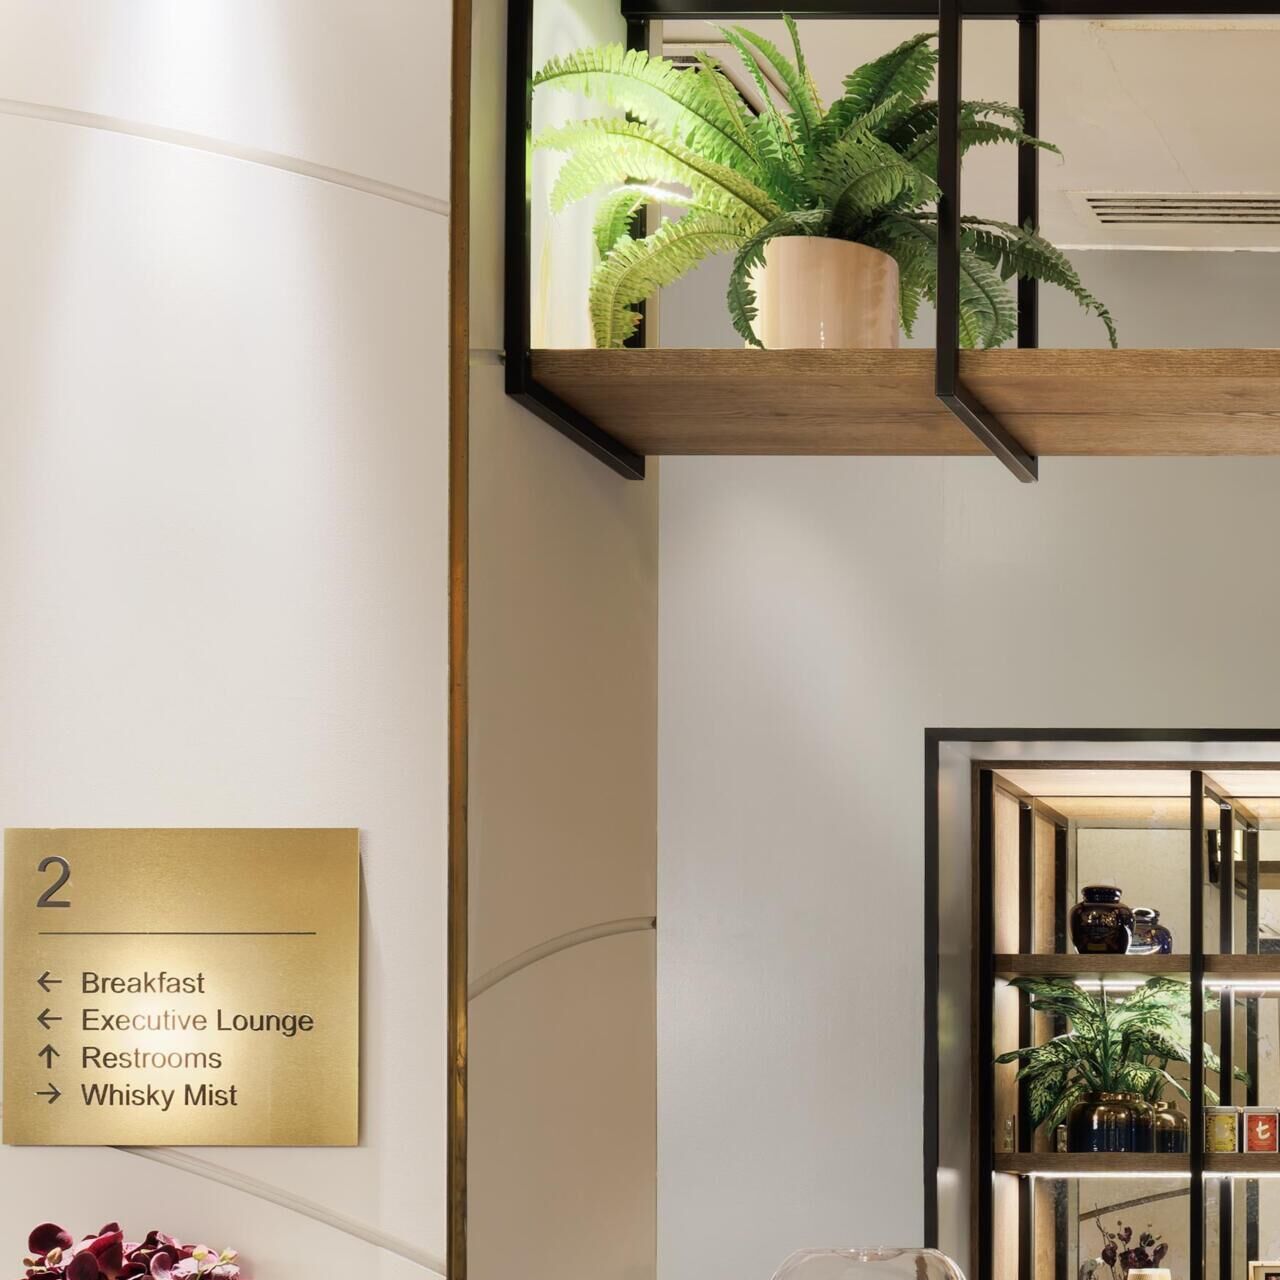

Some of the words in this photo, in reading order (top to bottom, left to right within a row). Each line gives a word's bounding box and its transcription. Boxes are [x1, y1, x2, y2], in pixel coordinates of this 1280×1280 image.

[36, 856, 71, 908] 2
[82, 972, 205, 994] Breakfast
[82, 1009, 207, 1031] Executive
[217, 1009, 314, 1037] Lounge
[82, 1047, 222, 1069] Restrooms
[81, 1084, 175, 1111] Whisky
[184, 1084, 238, 1106] Mist
